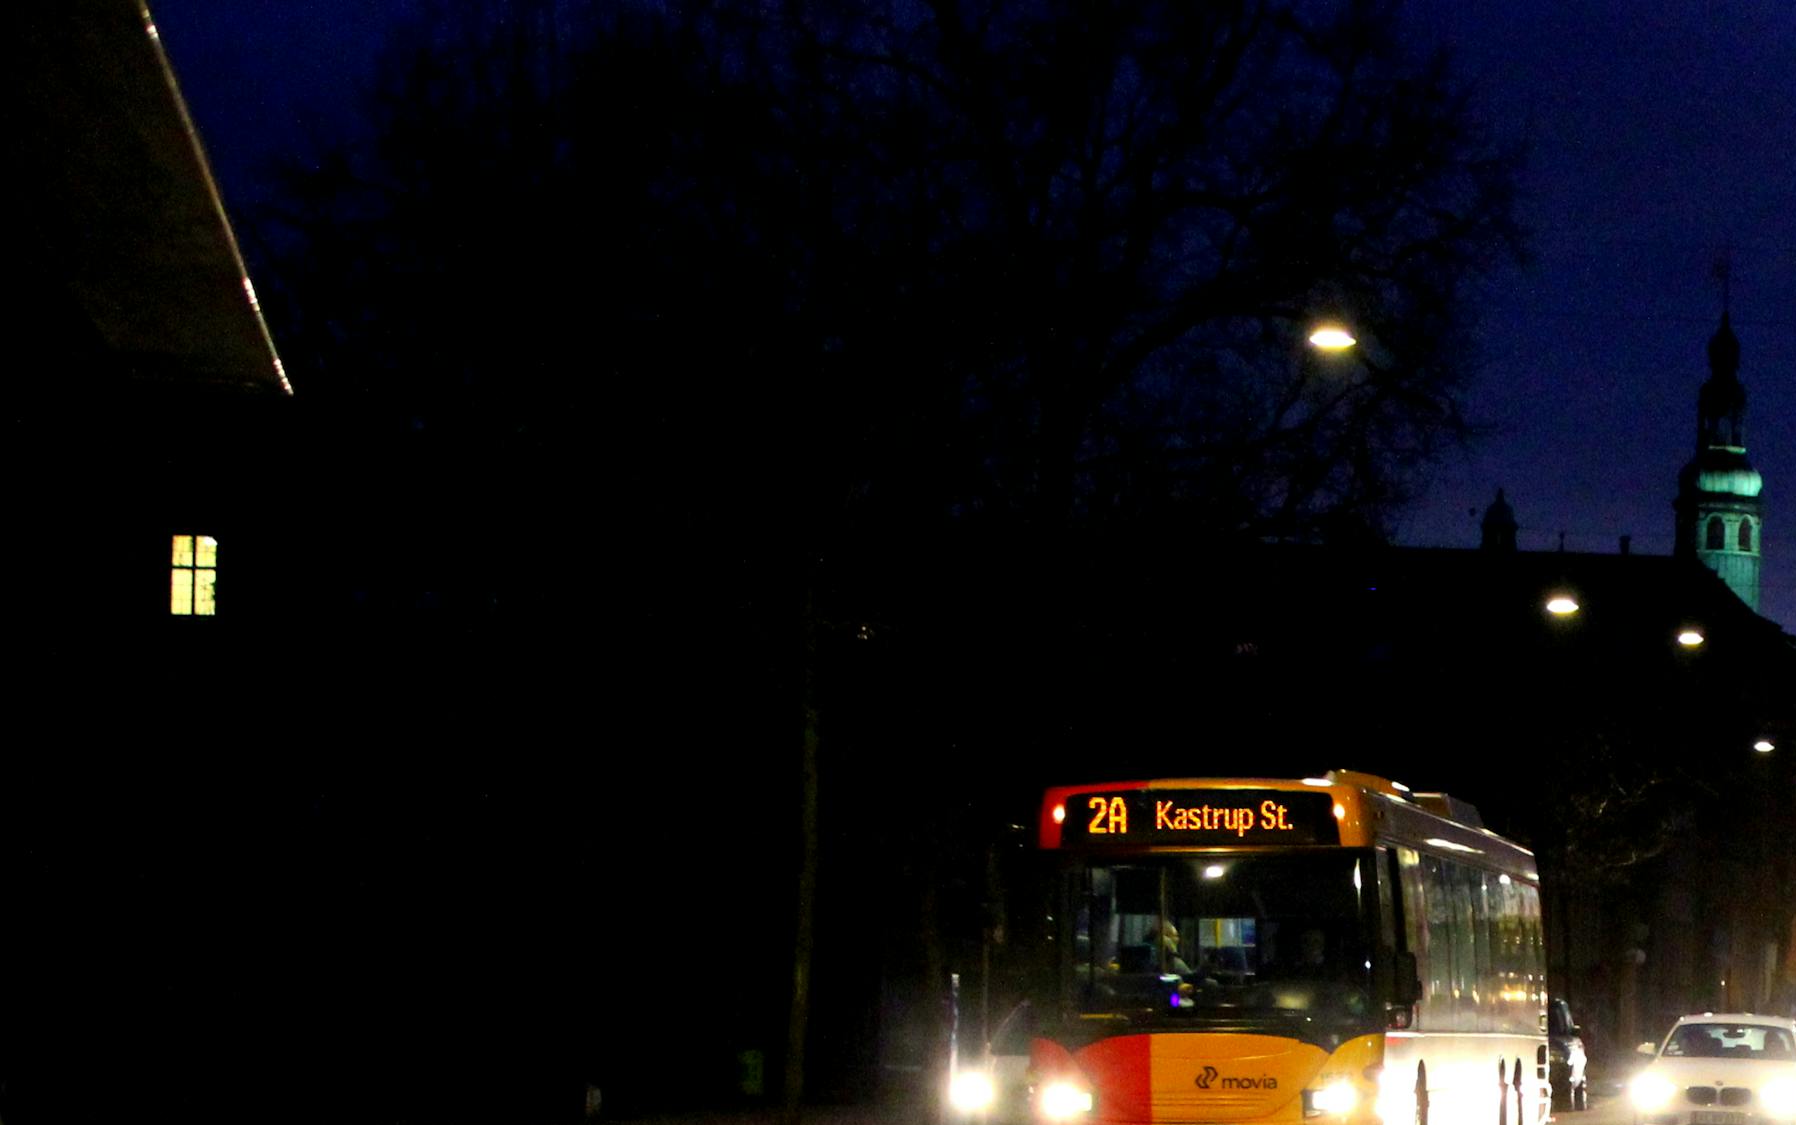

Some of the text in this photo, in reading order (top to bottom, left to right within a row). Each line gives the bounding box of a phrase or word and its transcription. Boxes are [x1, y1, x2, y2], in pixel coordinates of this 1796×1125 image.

[1088, 796, 1294, 837] 2A Kastrup St.
[1222, 1073, 1278, 1090] movia
